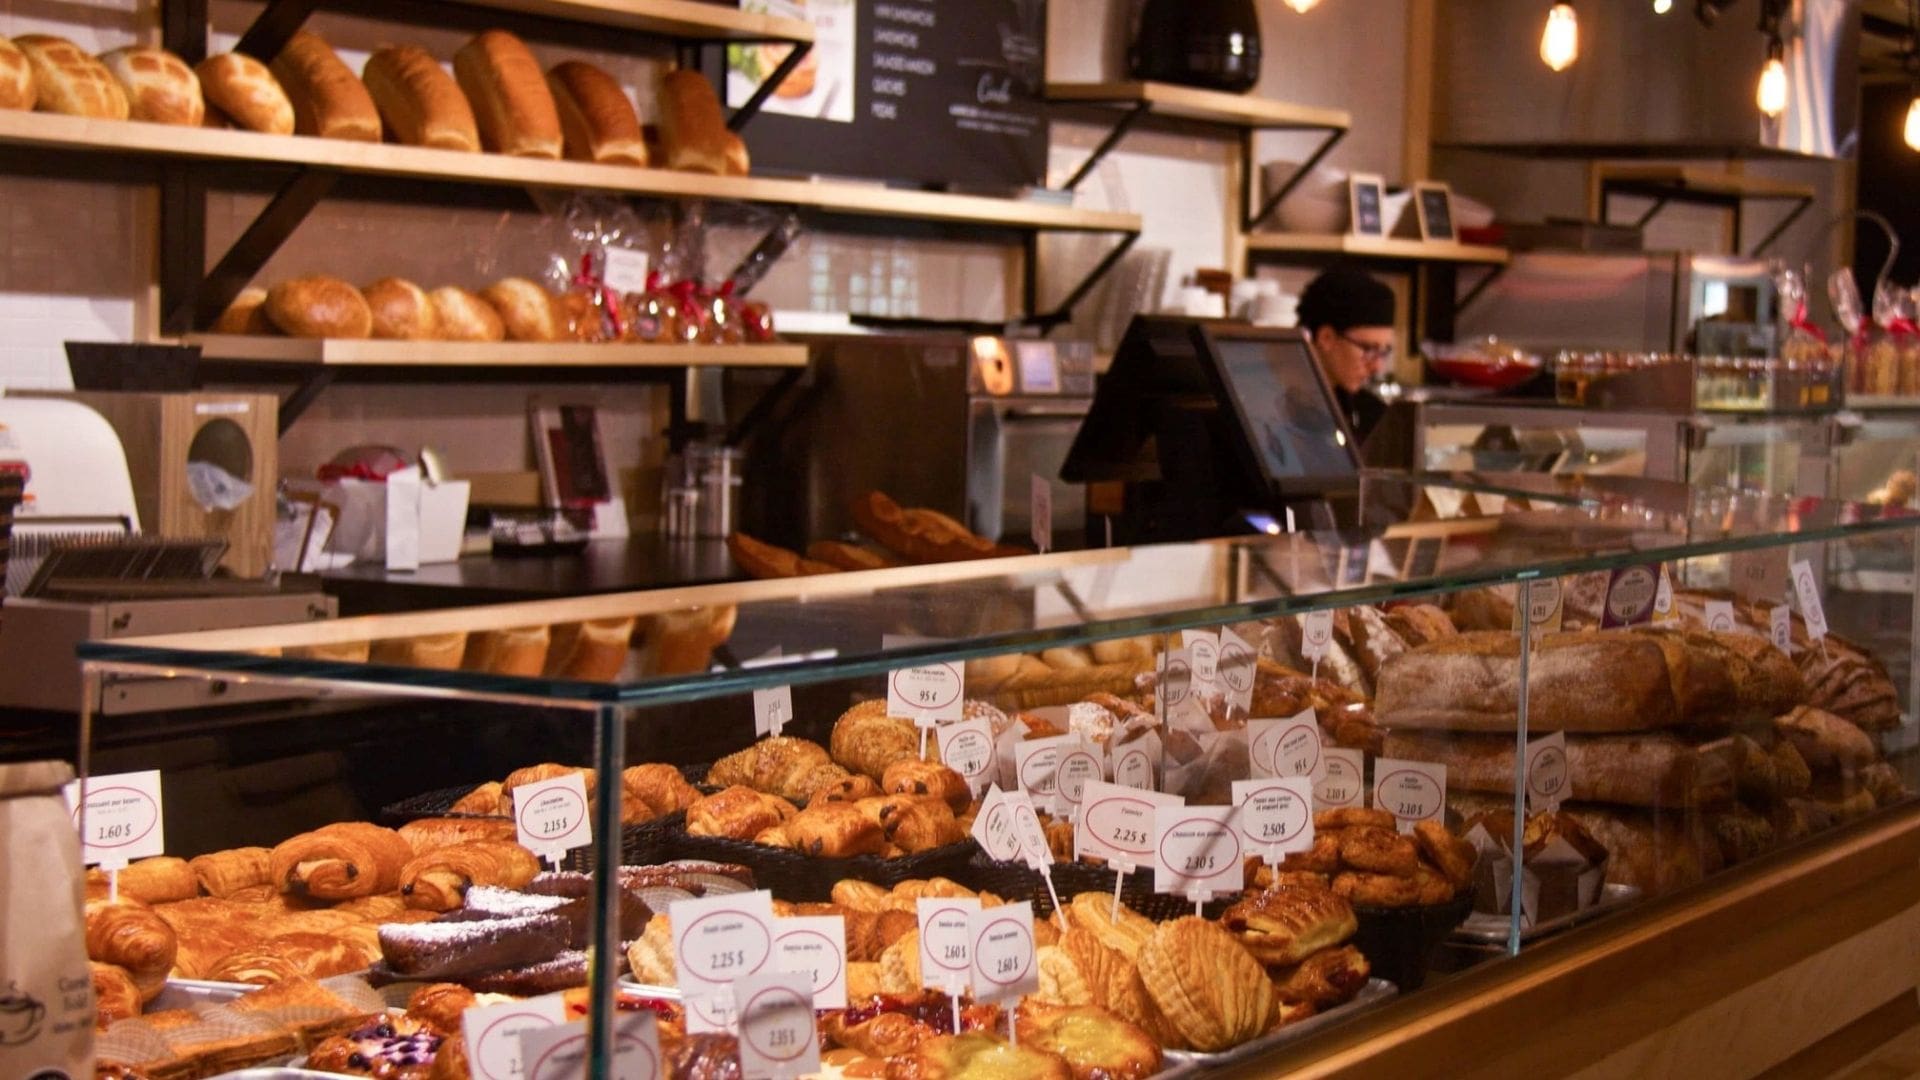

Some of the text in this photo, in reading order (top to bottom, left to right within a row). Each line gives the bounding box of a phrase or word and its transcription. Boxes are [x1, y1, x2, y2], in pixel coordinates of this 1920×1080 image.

[920, 690, 930, 702] 95
[1399, 802, 1417, 815] 2.10
[98, 822, 132, 840] 1.60 $
[543, 816, 567, 834] 2.15 $
[1113, 827, 1147, 844] 2.25 $
[1185, 856, 1215, 870] 2.30 $
[711, 949, 744, 970] 2.25 $
[944, 945, 966, 959] 2.60 $
[997, 955, 1019, 975] 2.60 $
